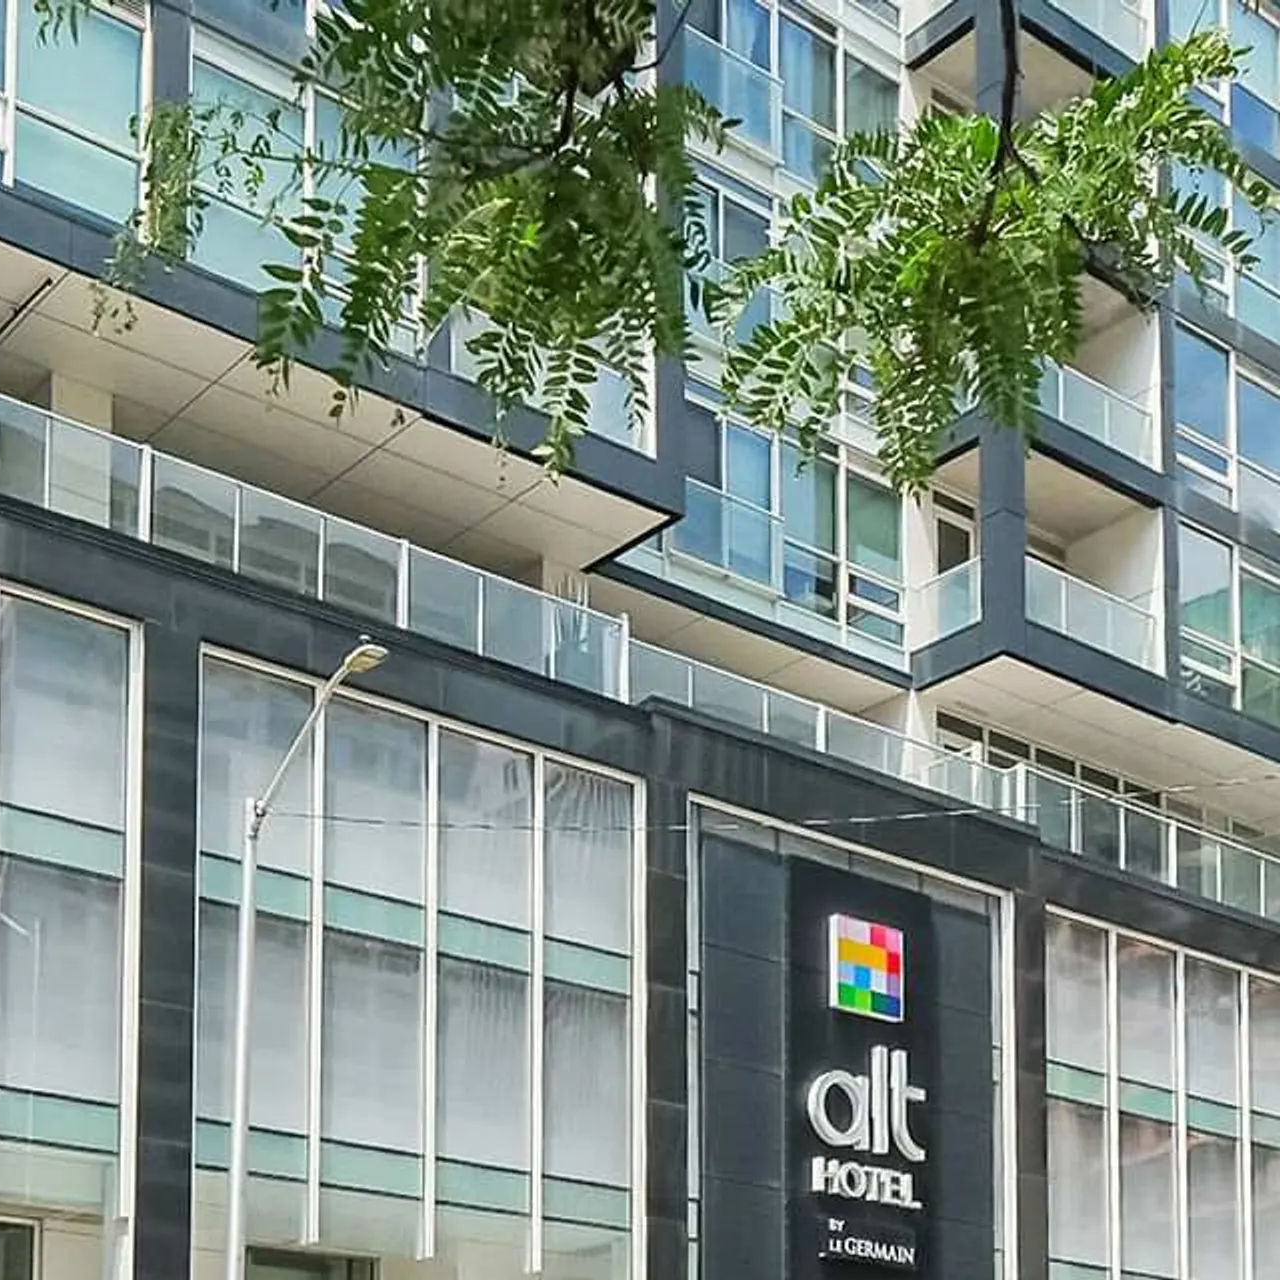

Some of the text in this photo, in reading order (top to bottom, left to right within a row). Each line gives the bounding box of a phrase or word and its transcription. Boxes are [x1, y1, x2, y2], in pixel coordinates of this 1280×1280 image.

[807, 1045, 926, 1162] alt
[811, 1156, 922, 1209] HOTEL
[828, 1218, 845, 1232] BY
[844, 1237, 915, 1265] GERMAIN
